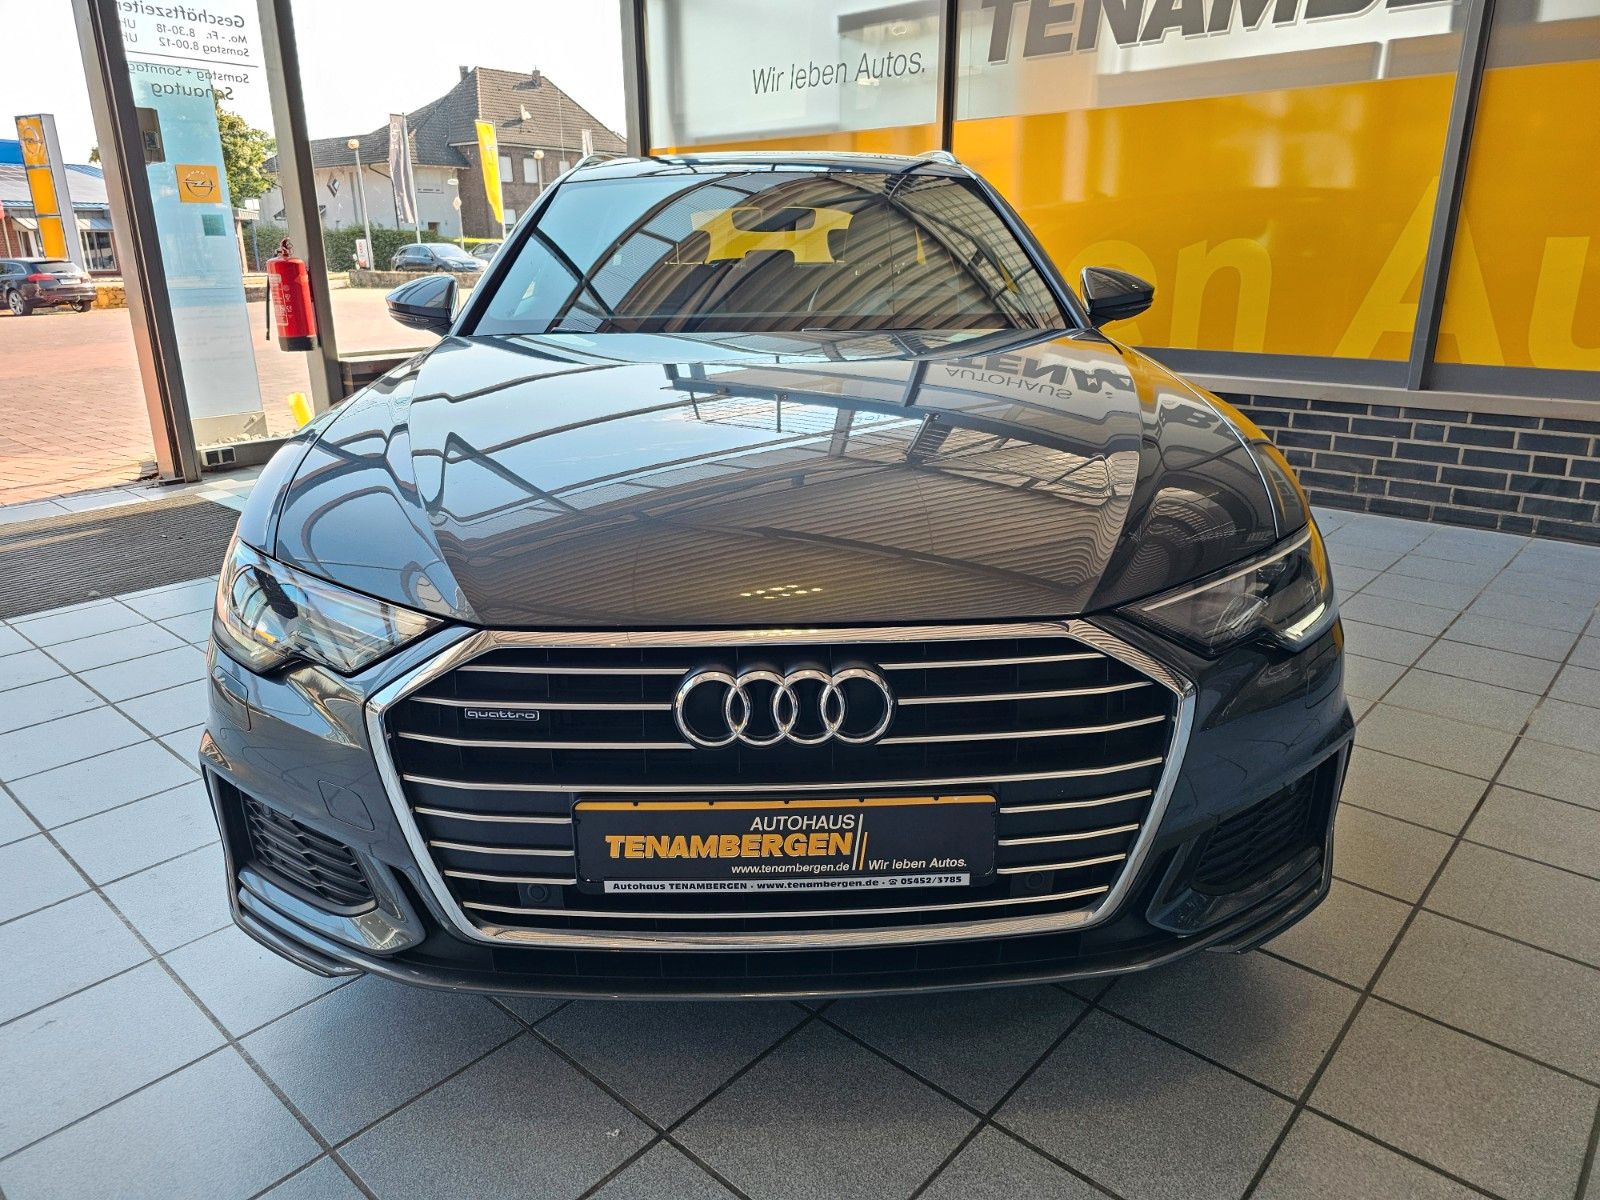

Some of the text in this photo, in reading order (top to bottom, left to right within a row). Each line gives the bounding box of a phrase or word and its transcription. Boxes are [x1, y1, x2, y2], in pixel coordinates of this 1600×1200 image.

[752, 51, 926, 95] Wir leben Autos.
[467, 710, 536, 719] quattro
[750, 814, 855, 831] AUTOHAUS
[605, 832, 854, 859] TENAMBERGEN
[731, 863, 850, 875] www.tenambergen.de
[868, 857, 967, 871] Wir leben Autos.
[613, 876, 962, 890] Autohaus TENAMBERGEN www.tenambergen.de 05452/3785
